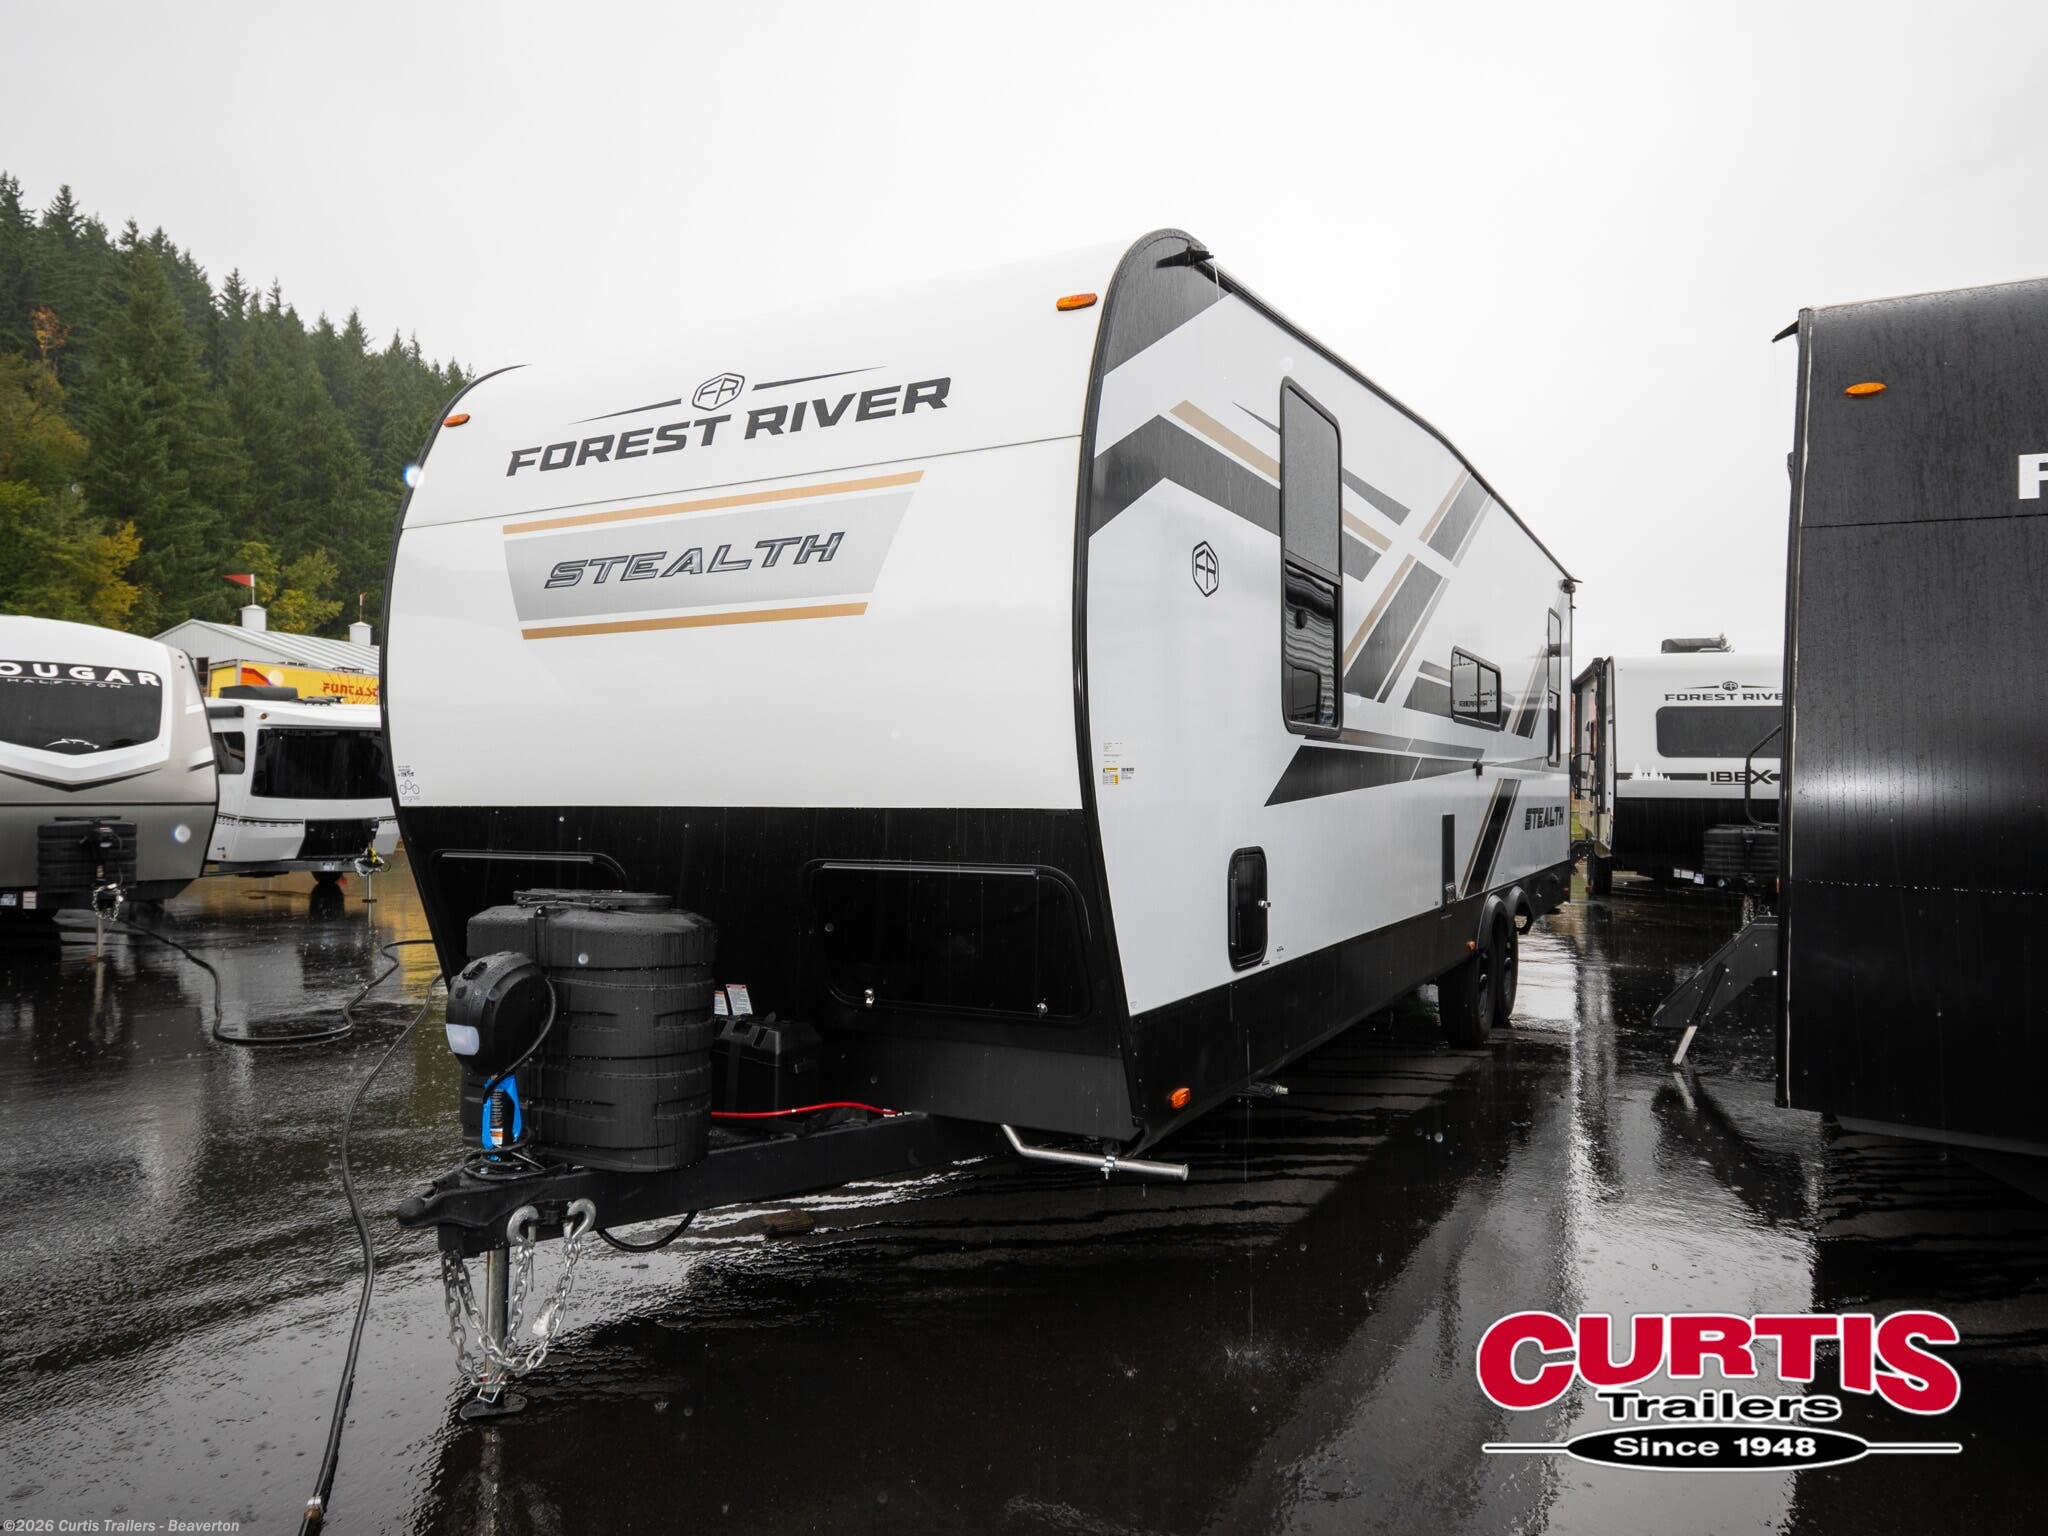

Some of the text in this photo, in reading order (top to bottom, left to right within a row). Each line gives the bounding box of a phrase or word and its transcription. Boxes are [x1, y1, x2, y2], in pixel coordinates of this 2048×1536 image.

[506, 376, 951, 477] FOREST RIVER
[543, 531, 845, 589] STEALTH
[0, 661, 160, 687] OUGAR
[1664, 693, 1738, 701] FOREST
[1710, 769, 1773, 784] IBEX
[1525, 806, 1564, 830] STEALTH
